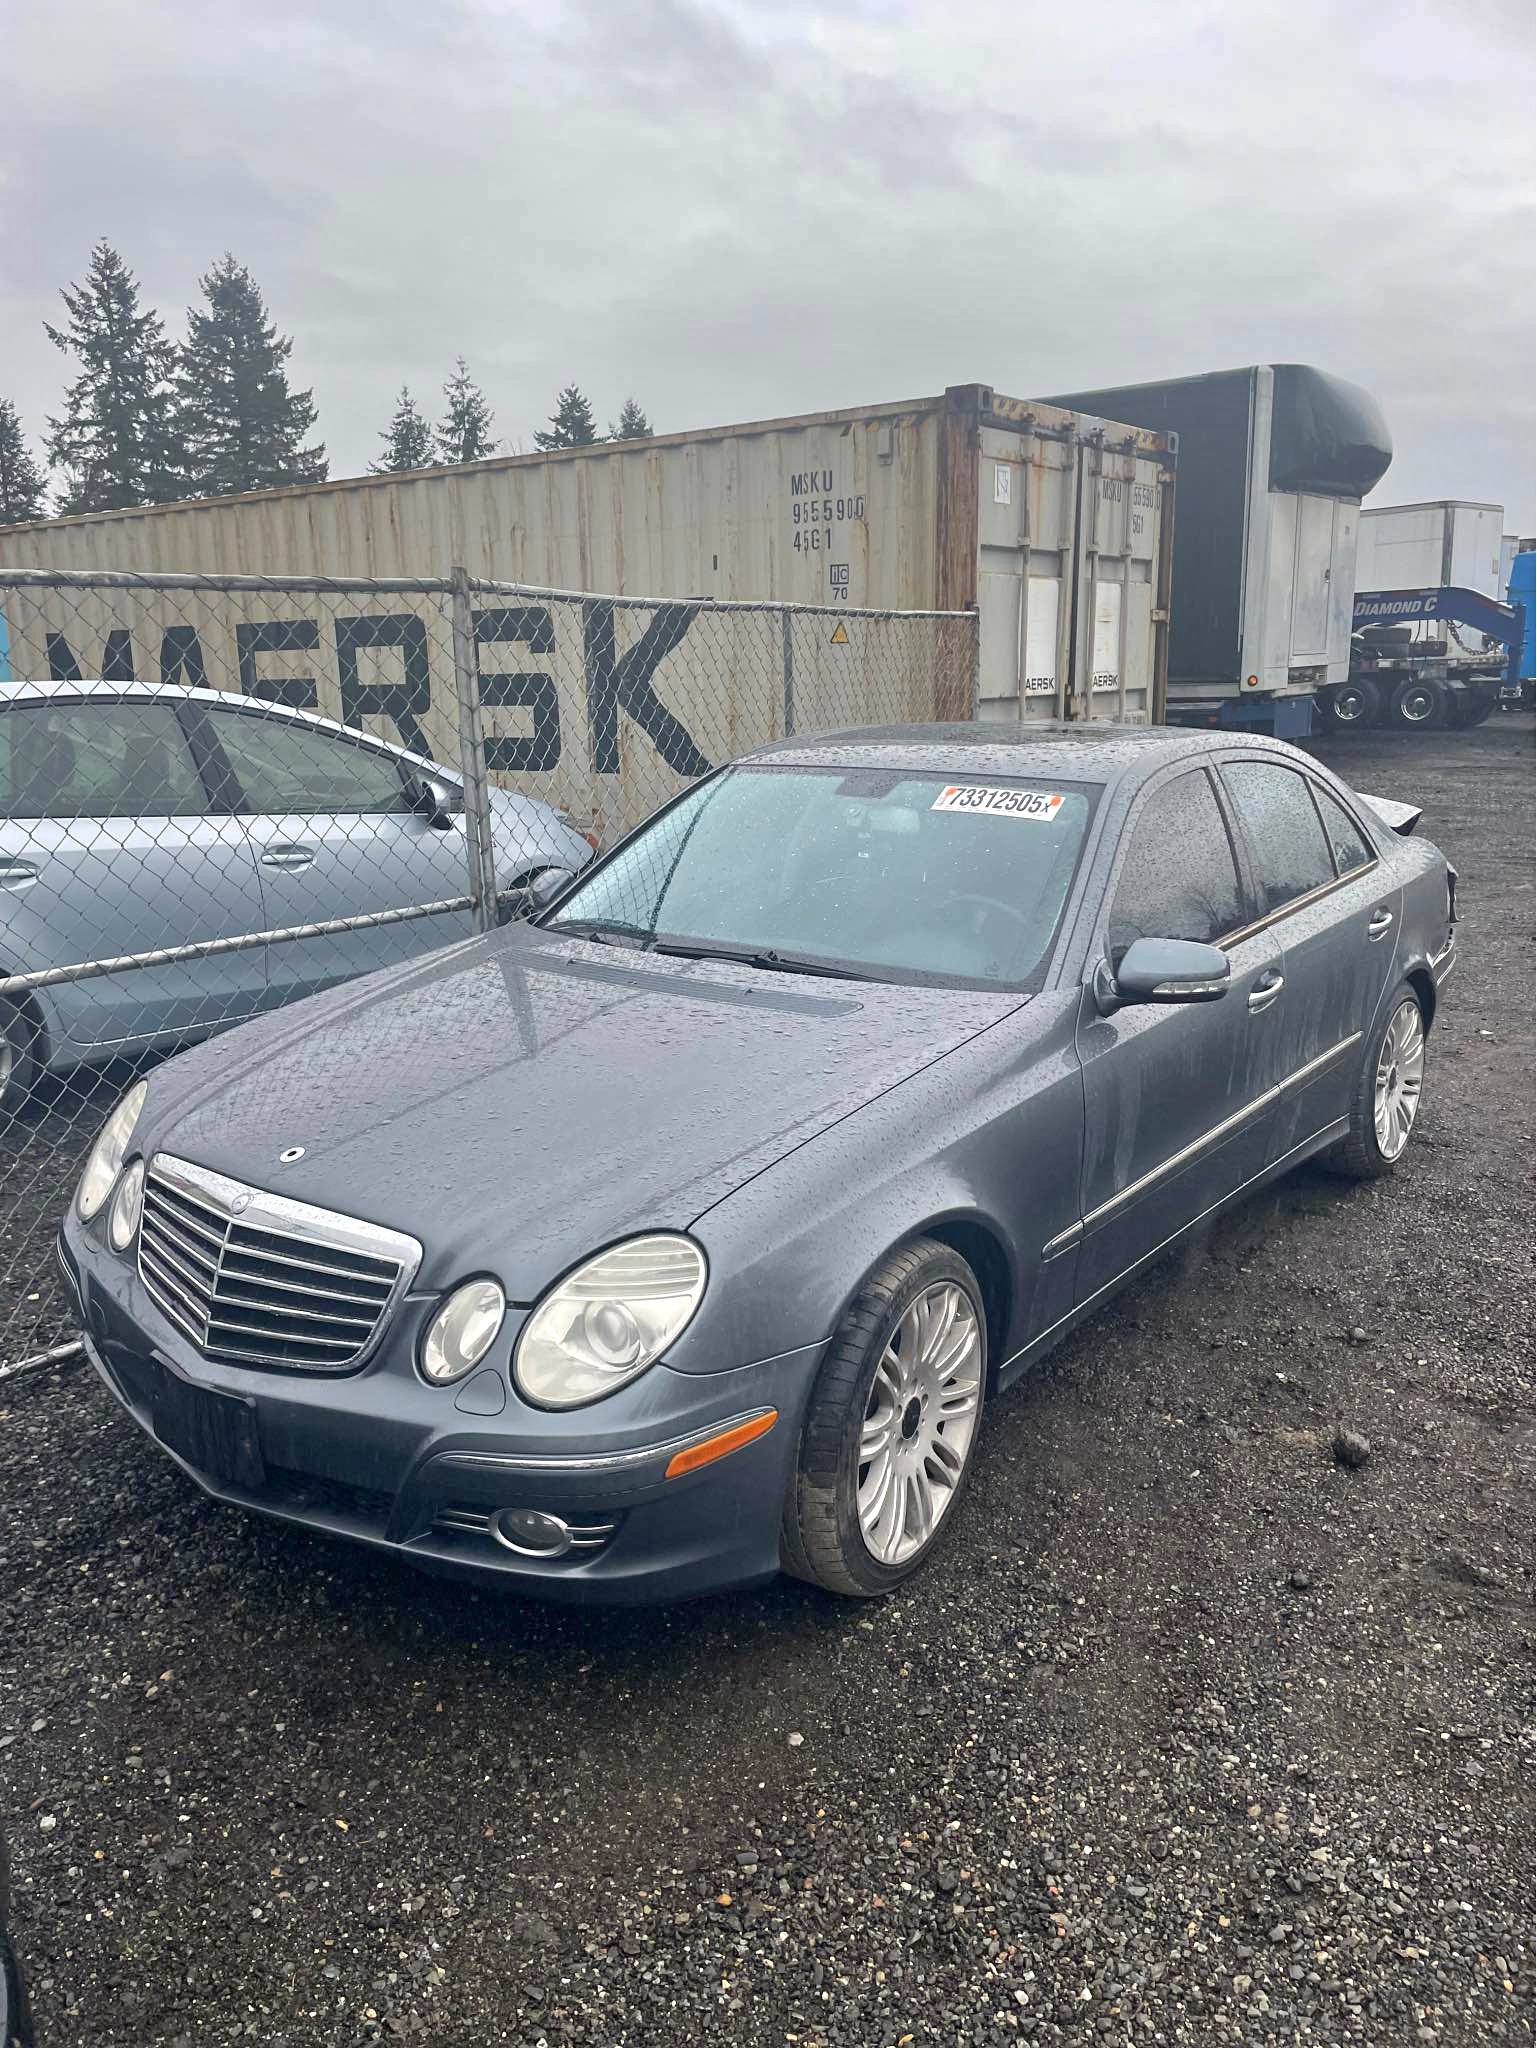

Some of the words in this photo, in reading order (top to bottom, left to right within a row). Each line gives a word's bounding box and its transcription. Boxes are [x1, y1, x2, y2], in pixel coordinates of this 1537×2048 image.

[791, 470, 833, 496] MSKU
[1103, 479, 1121, 503] MSKU
[1132, 514, 1143, 535] 5G1
[793, 528, 832, 552] 45G1
[832, 587, 848, 600] 70
[1353, 601, 1422, 617] DIAMOND
[1424, 596, 1438, 612] C
[1026, 677, 1055, 690] AERSK
[1092, 675, 1118, 687] AERSK
